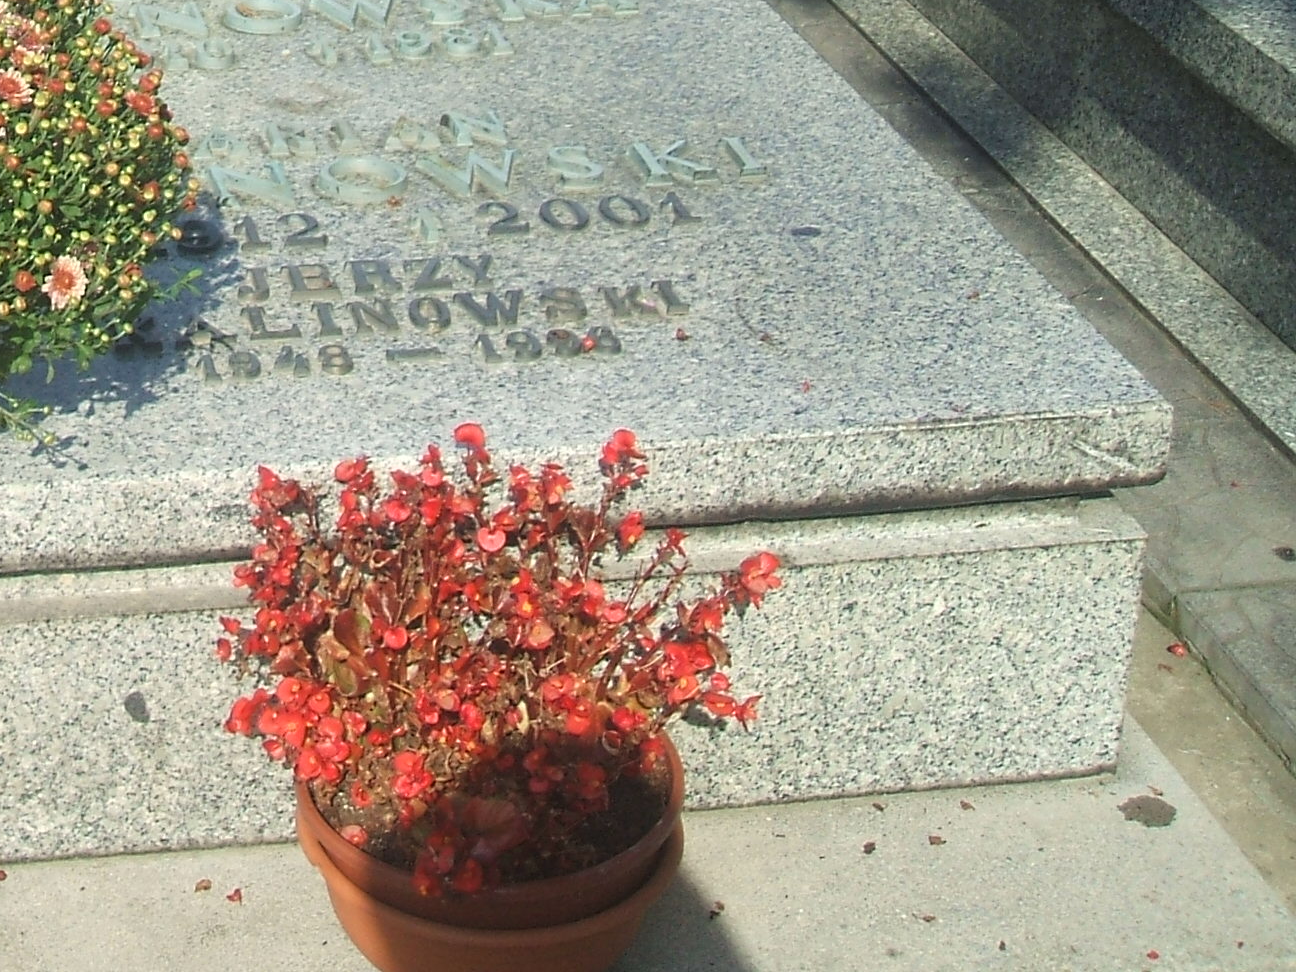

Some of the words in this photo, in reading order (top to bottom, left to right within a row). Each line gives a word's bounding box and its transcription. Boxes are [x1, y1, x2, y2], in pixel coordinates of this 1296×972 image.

[207, 136, 767, 208] NOWSKI
[476, 191, 702, 235] 2001
[236, 254, 494, 303] JERZY
